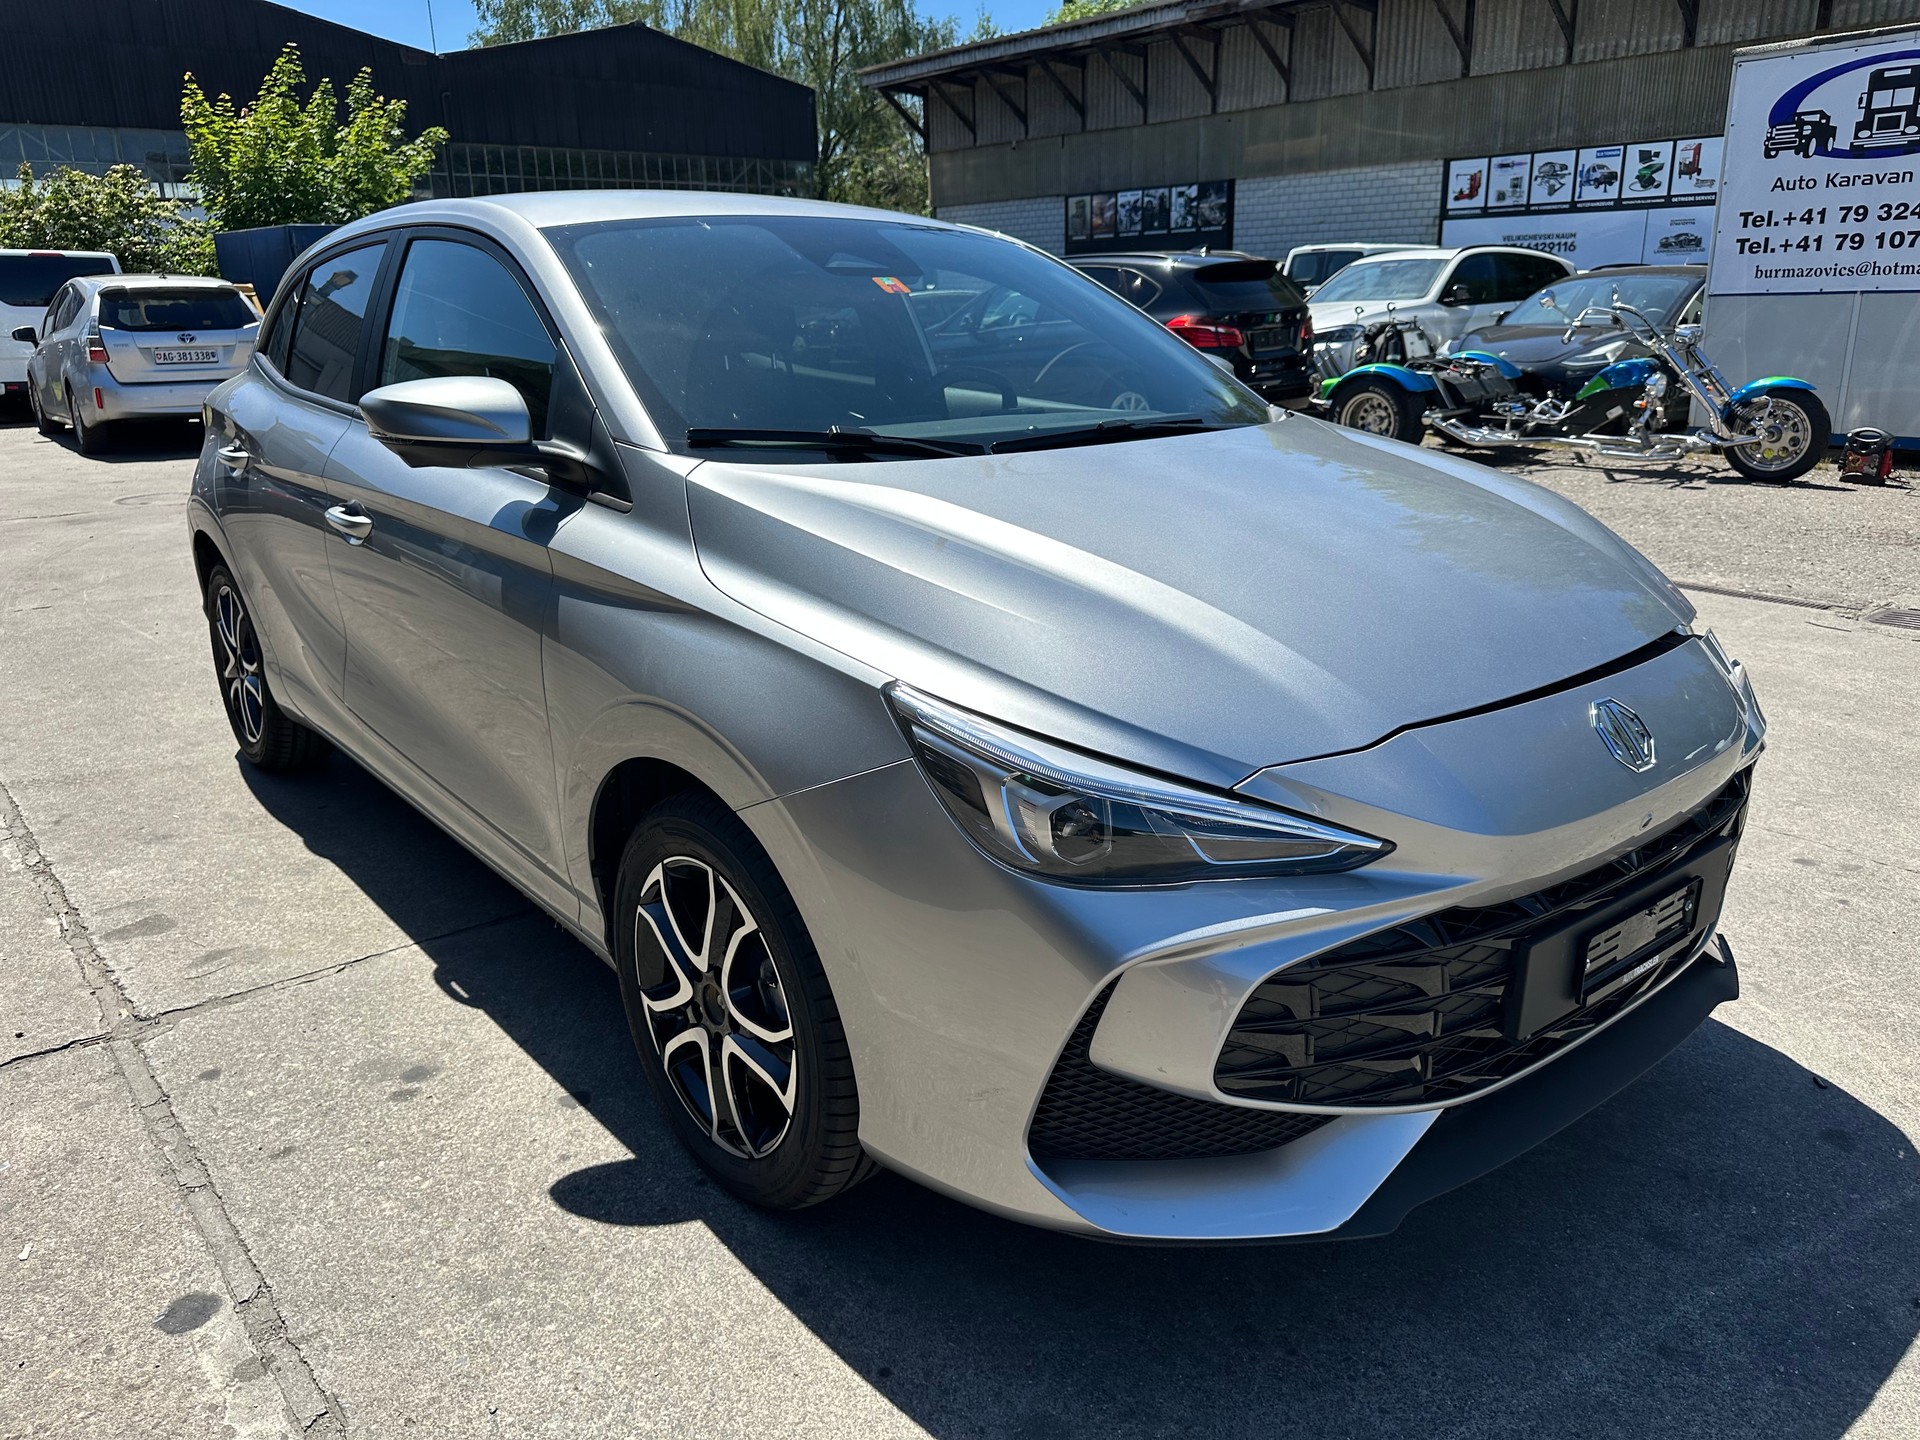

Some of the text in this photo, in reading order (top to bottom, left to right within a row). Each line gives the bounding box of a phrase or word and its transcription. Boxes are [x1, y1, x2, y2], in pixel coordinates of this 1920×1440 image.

[1770, 171, 1914, 192] Auto Karavan
[1739, 207, 1827, 228] Tel.+41
[1839, 205, 1869, 223] 79
[1555, 231, 1577, 240] NAUM
[1735, 230, 1920, 255] Tel.+41 79 107
